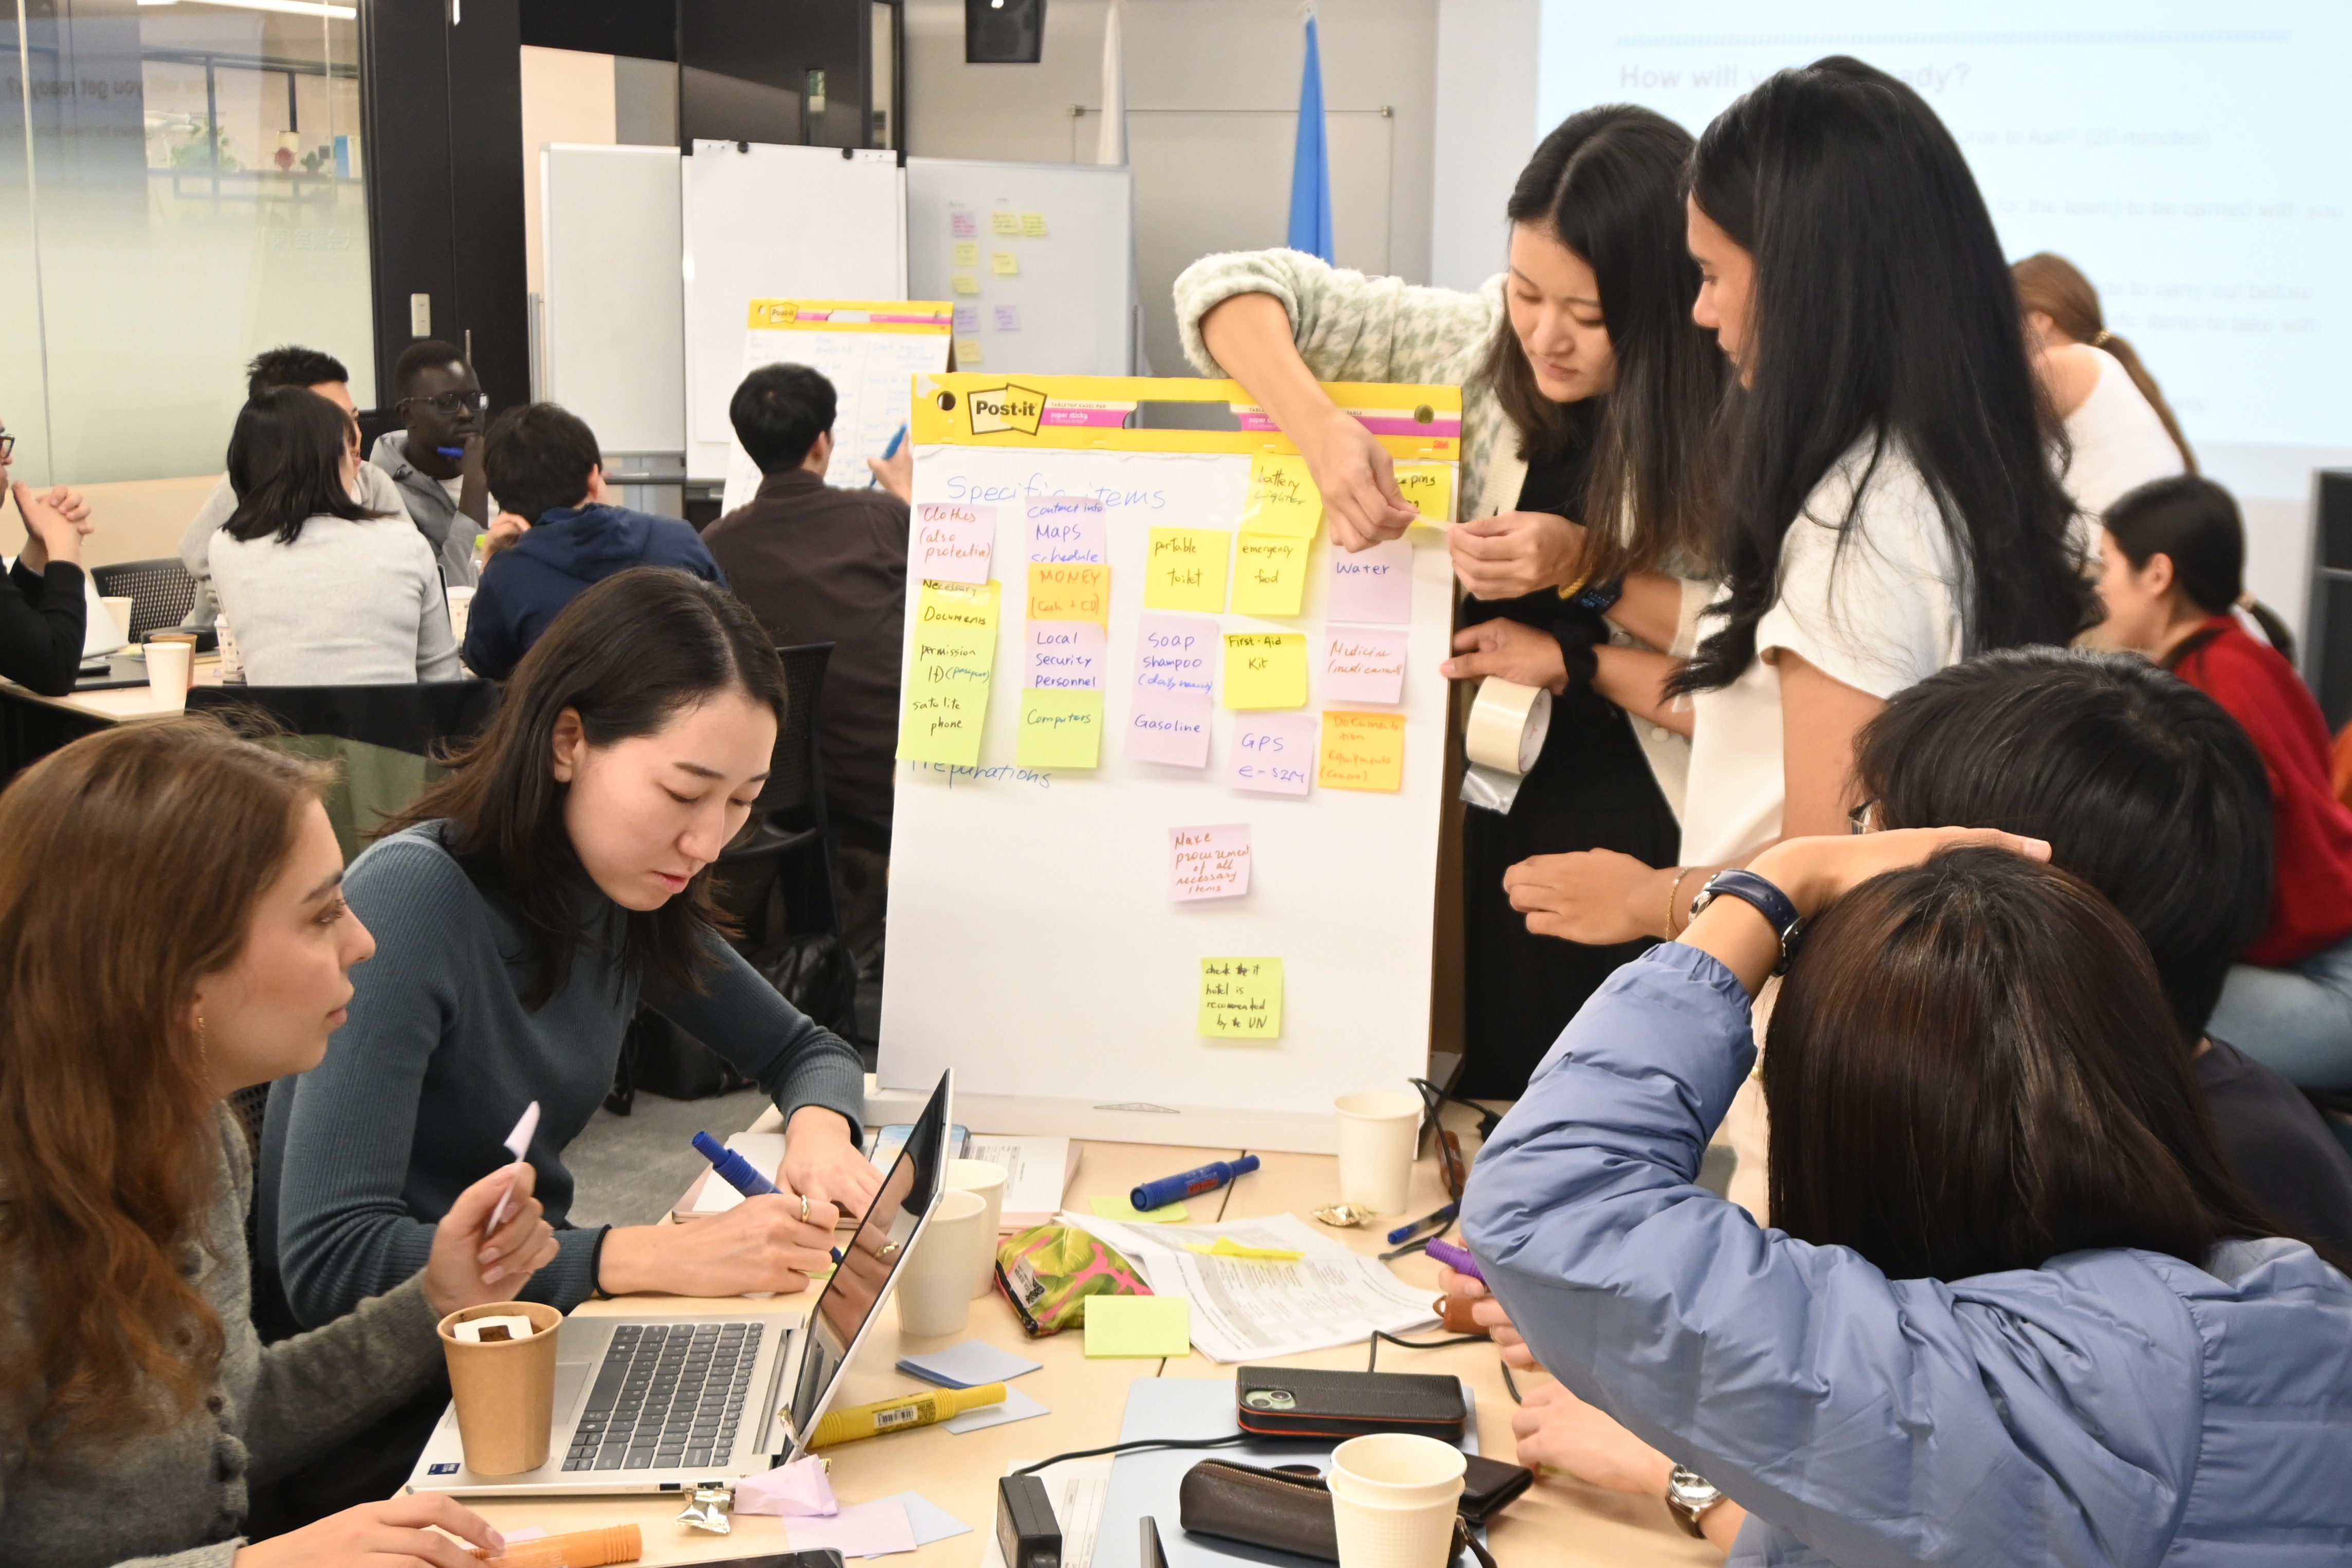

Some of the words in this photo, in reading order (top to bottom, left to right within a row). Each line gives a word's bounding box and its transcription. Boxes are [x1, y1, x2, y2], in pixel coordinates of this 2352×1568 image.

[1620, 64, 1683, 88] How
[1692, 63, 1738, 88] will
[976, 400, 1036, 417] Post-it
[1069, 411, 1088, 420] sticky
[1433, 440, 1449, 450] 3M
[1257, 465, 1301, 496] battery
[1397, 475, 1436, 489] eping
[923, 507, 976, 523] Clothes
[1027, 503, 1079, 519] Contact
[1083, 501, 1103, 514] info
[1154, 536, 1197, 557] portable
[1040, 568, 1102, 587] MONEY
[1166, 567, 1205, 587] toilet
[1254, 568, 1280, 585] food
[1036, 631, 1078, 645] Local
[920, 643, 977, 663] permission
[1329, 639, 1393, 658] Medicine
[1248, 657, 1270, 670] Kit
[931, 716, 964, 737] phone
[1027, 708, 1092, 730] Computers
[1134, 714, 1202, 733] Gasoline
[1241, 732, 1285, 752] GPS
[1175, 832, 1213, 850] Make
[1193, 861, 1206, 874] of
[1216, 859, 1233, 870] all
[1176, 871, 1238, 886] necessary
[1188, 884, 1221, 894] items
[1205, 982, 1229, 996] hotel
[1235, 986, 1245, 995] is
[1216, 1013, 1228, 1031] by
[1231, 1016, 1242, 1028] the
[1248, 1014, 1268, 1029] UN
